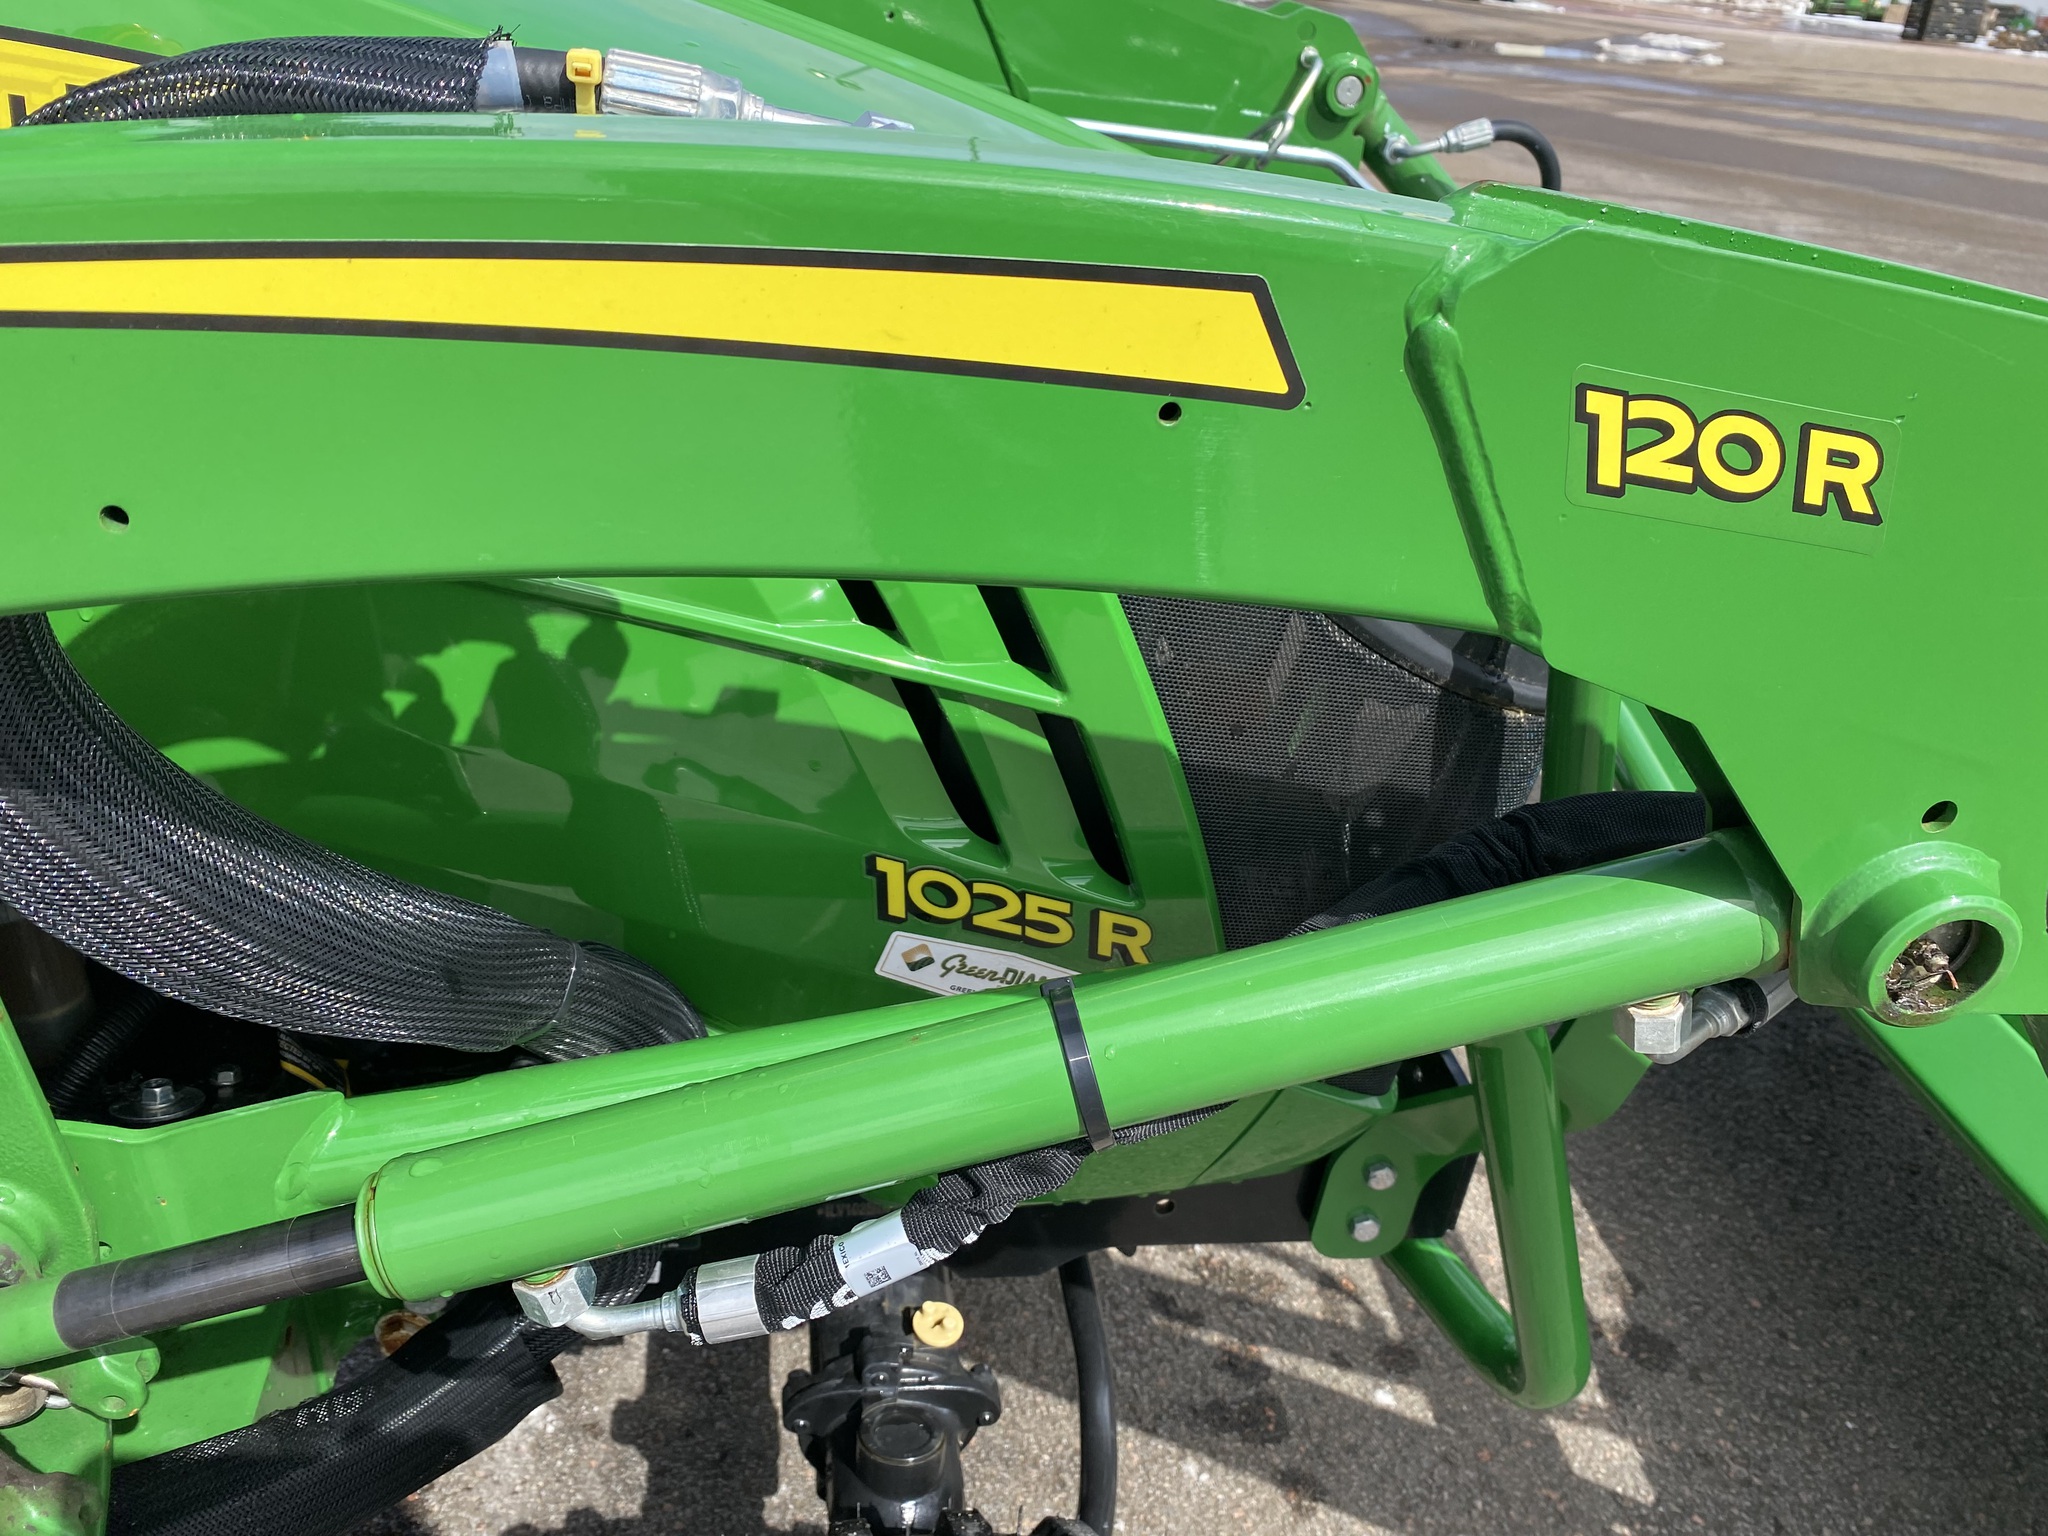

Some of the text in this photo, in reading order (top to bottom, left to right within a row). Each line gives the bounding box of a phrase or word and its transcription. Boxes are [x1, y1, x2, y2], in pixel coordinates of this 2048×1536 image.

[1575, 383, 1884, 526] 120 R
[865, 852, 1153, 966] 1025 R
